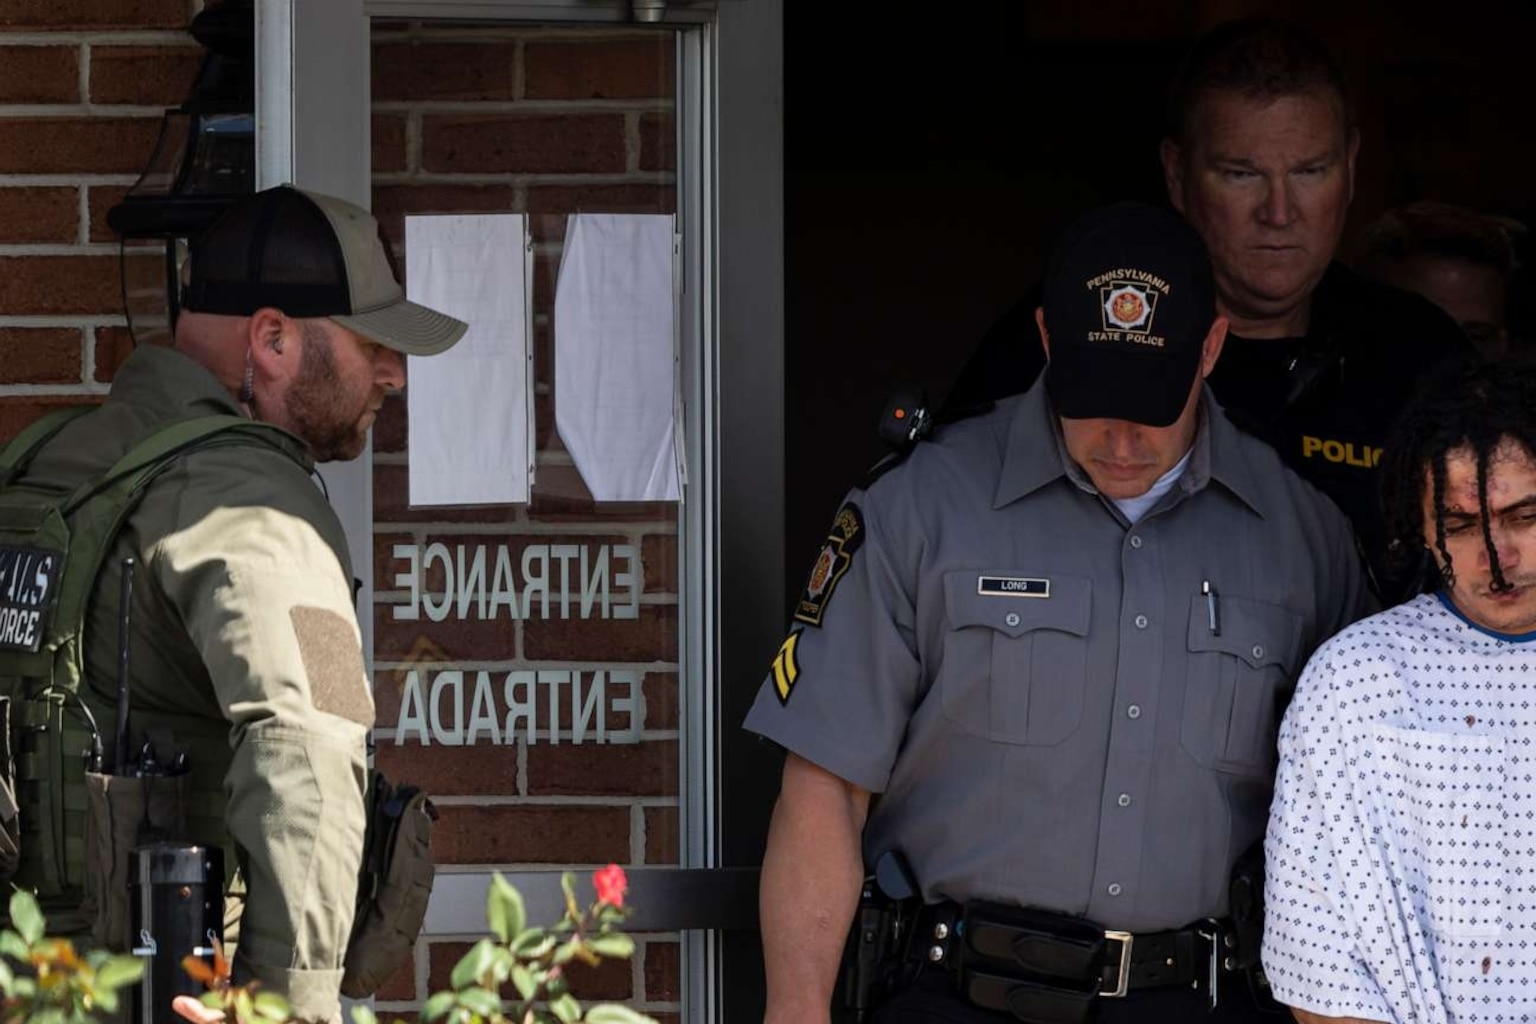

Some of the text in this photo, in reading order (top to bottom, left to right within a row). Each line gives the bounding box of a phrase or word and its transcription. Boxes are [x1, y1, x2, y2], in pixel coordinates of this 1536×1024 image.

[1086, 268, 1170, 295] PENNSYLVANIA
[1087, 331, 1165, 347] STATE POLICE
[1302, 435, 1384, 468] POLIC
[1000, 580, 1028, 591] LONG
[0, 606, 40, 647] ORCE
